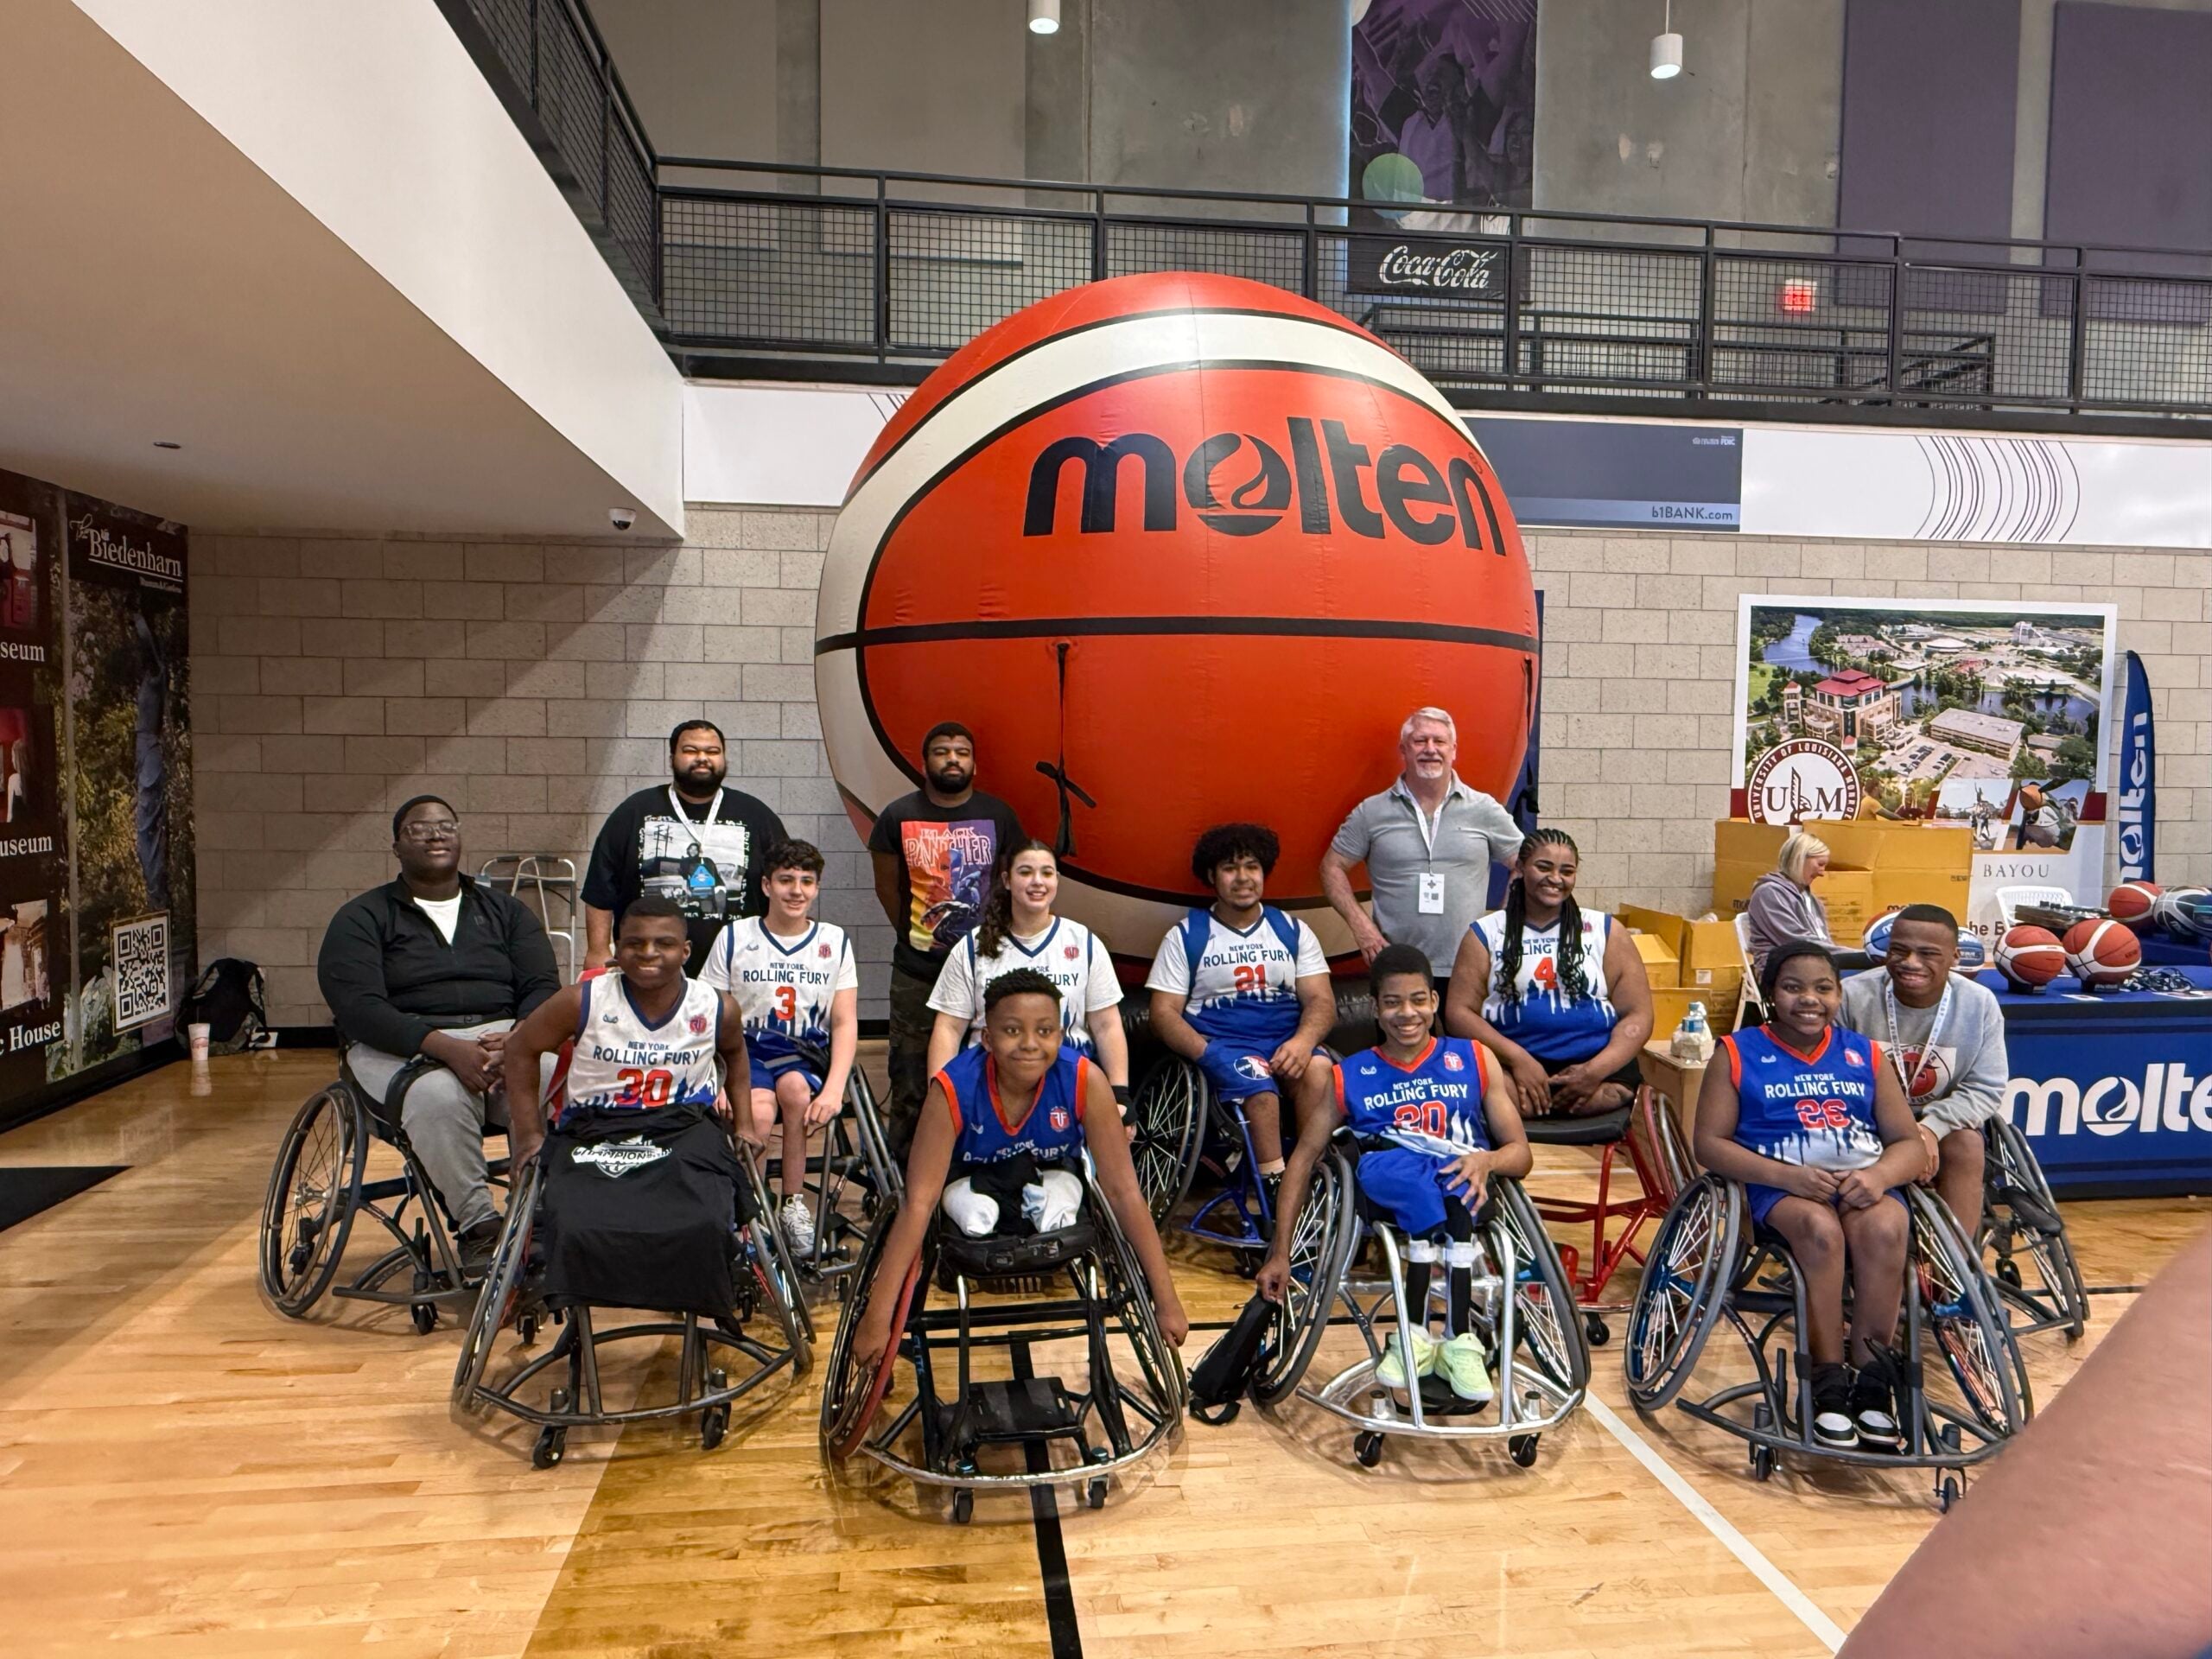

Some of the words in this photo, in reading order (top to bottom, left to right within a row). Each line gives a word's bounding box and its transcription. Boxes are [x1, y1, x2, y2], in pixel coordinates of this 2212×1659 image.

[1379, 245, 1499, 289] Coca-Cola
[1023, 416, 1507, 556] molten
[1651, 505, 1733, 521] b1BANK.com
[88, 529, 182, 577] Biedenharn
[0, 641, 46, 662] seum
[1752, 755, 1778, 818] UNIVERSITY
[1780, 745, 1792, 757] OF
[1798, 742, 1849, 772] LOUISIANA
[1983, 864, 2049, 878] BAYOU
[1968, 920, 1989, 936] he
[1204, 951, 1256, 968] ROLLING
[1262, 950, 1291, 962] FURY
[743, 969, 794, 983] ROLLING
[799, 971, 830, 985] FURY
[1234, 964, 1267, 991] 21
[1534, 957, 1557, 989] 4
[775, 986, 797, 1020] 3
[9, 1020, 61, 1052] House
[627, 1040, 646, 1049] NEW
[593, 1046, 657, 1065] ROLLING
[664, 1050, 700, 1065] FURY
[1393, 1081, 1410, 1090] NEW
[1412, 1077, 1433, 1086] YORK
[1764, 1082, 1828, 1098] ROLLING
[1832, 1082, 1865, 1096] FURY
[1363, 1087, 1426, 1110] ROLLING
[1431, 1084, 1467, 1098] FURY
